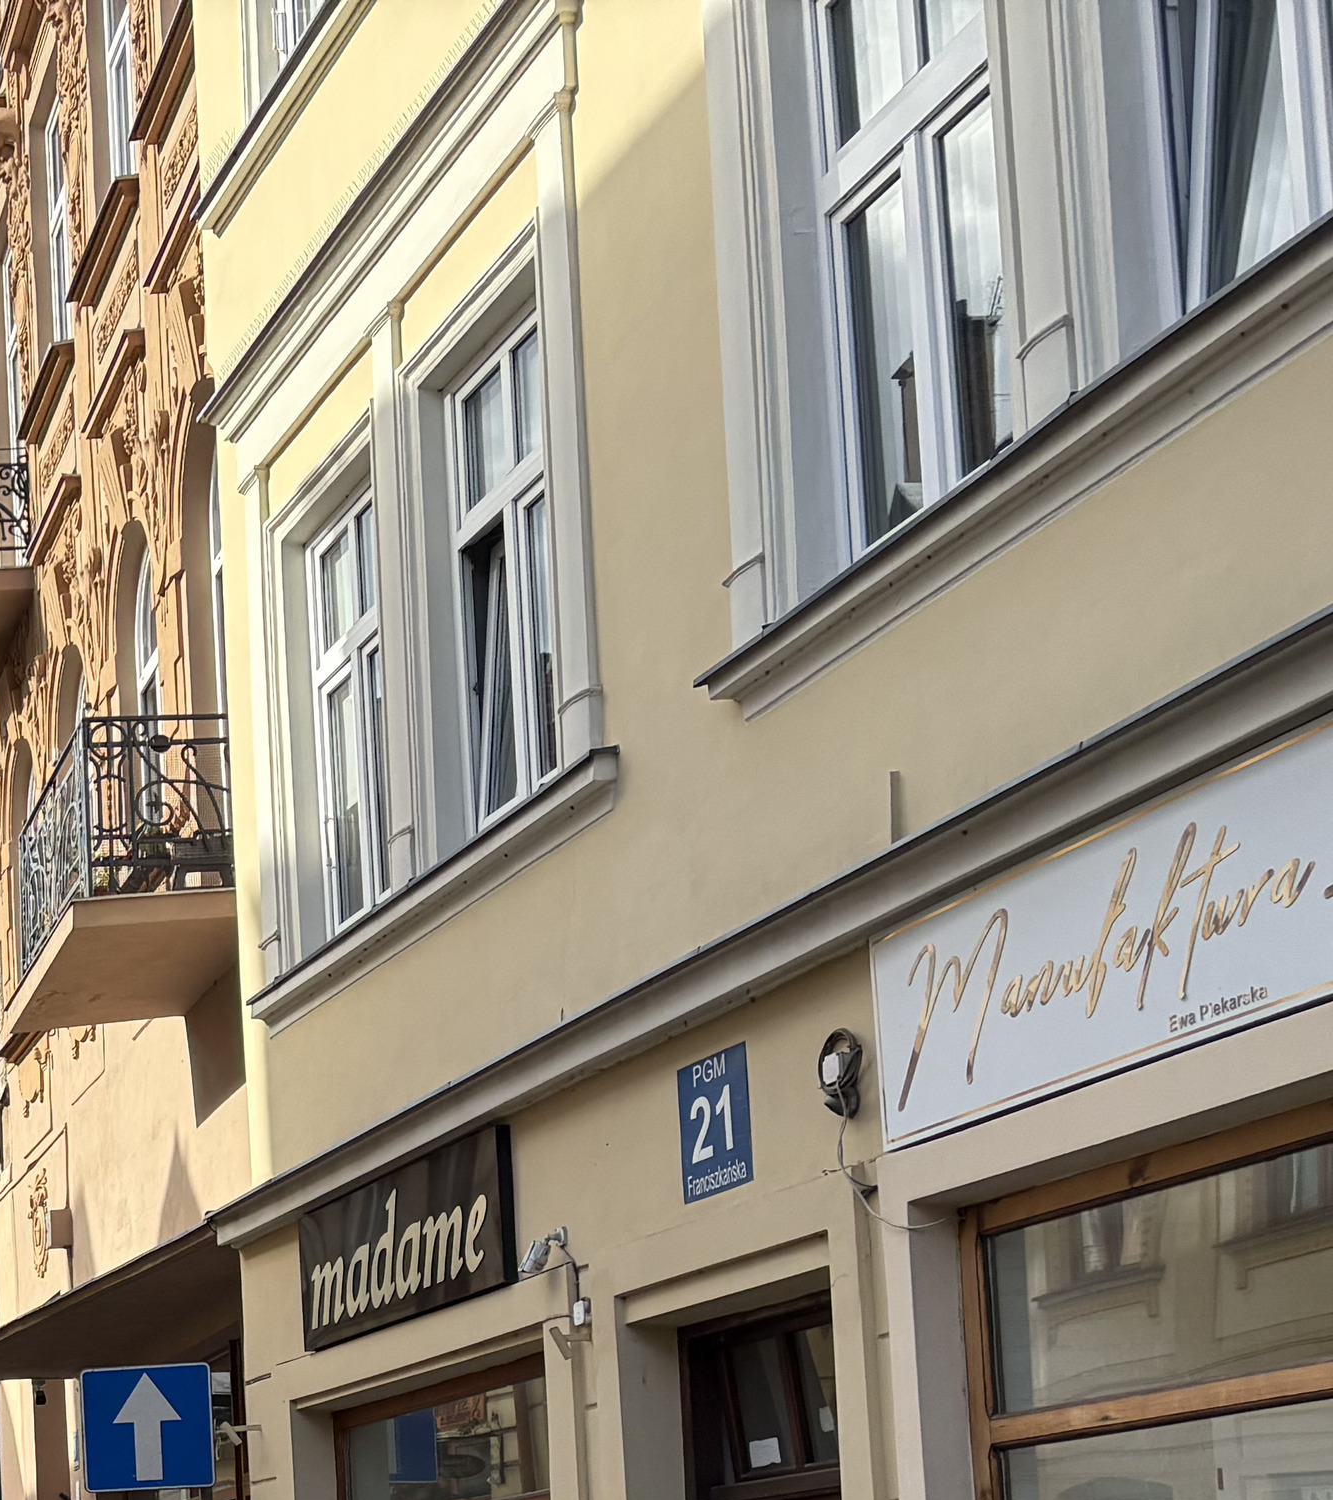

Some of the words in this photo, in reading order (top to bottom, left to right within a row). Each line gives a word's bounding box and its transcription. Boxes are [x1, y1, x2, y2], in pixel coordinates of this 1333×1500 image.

[898, 822, 1315, 1112] Manufaktura
[1169, 1009, 1197, 1033] Ewa
[1199, 985, 1269, 1022] Piekarska
[691, 1053, 727, 1088] PGM
[689, 1084, 735, 1165] 21
[686, 1159, 748, 1199] Franciszkańska
[309, 1188, 488, 1331] madame
